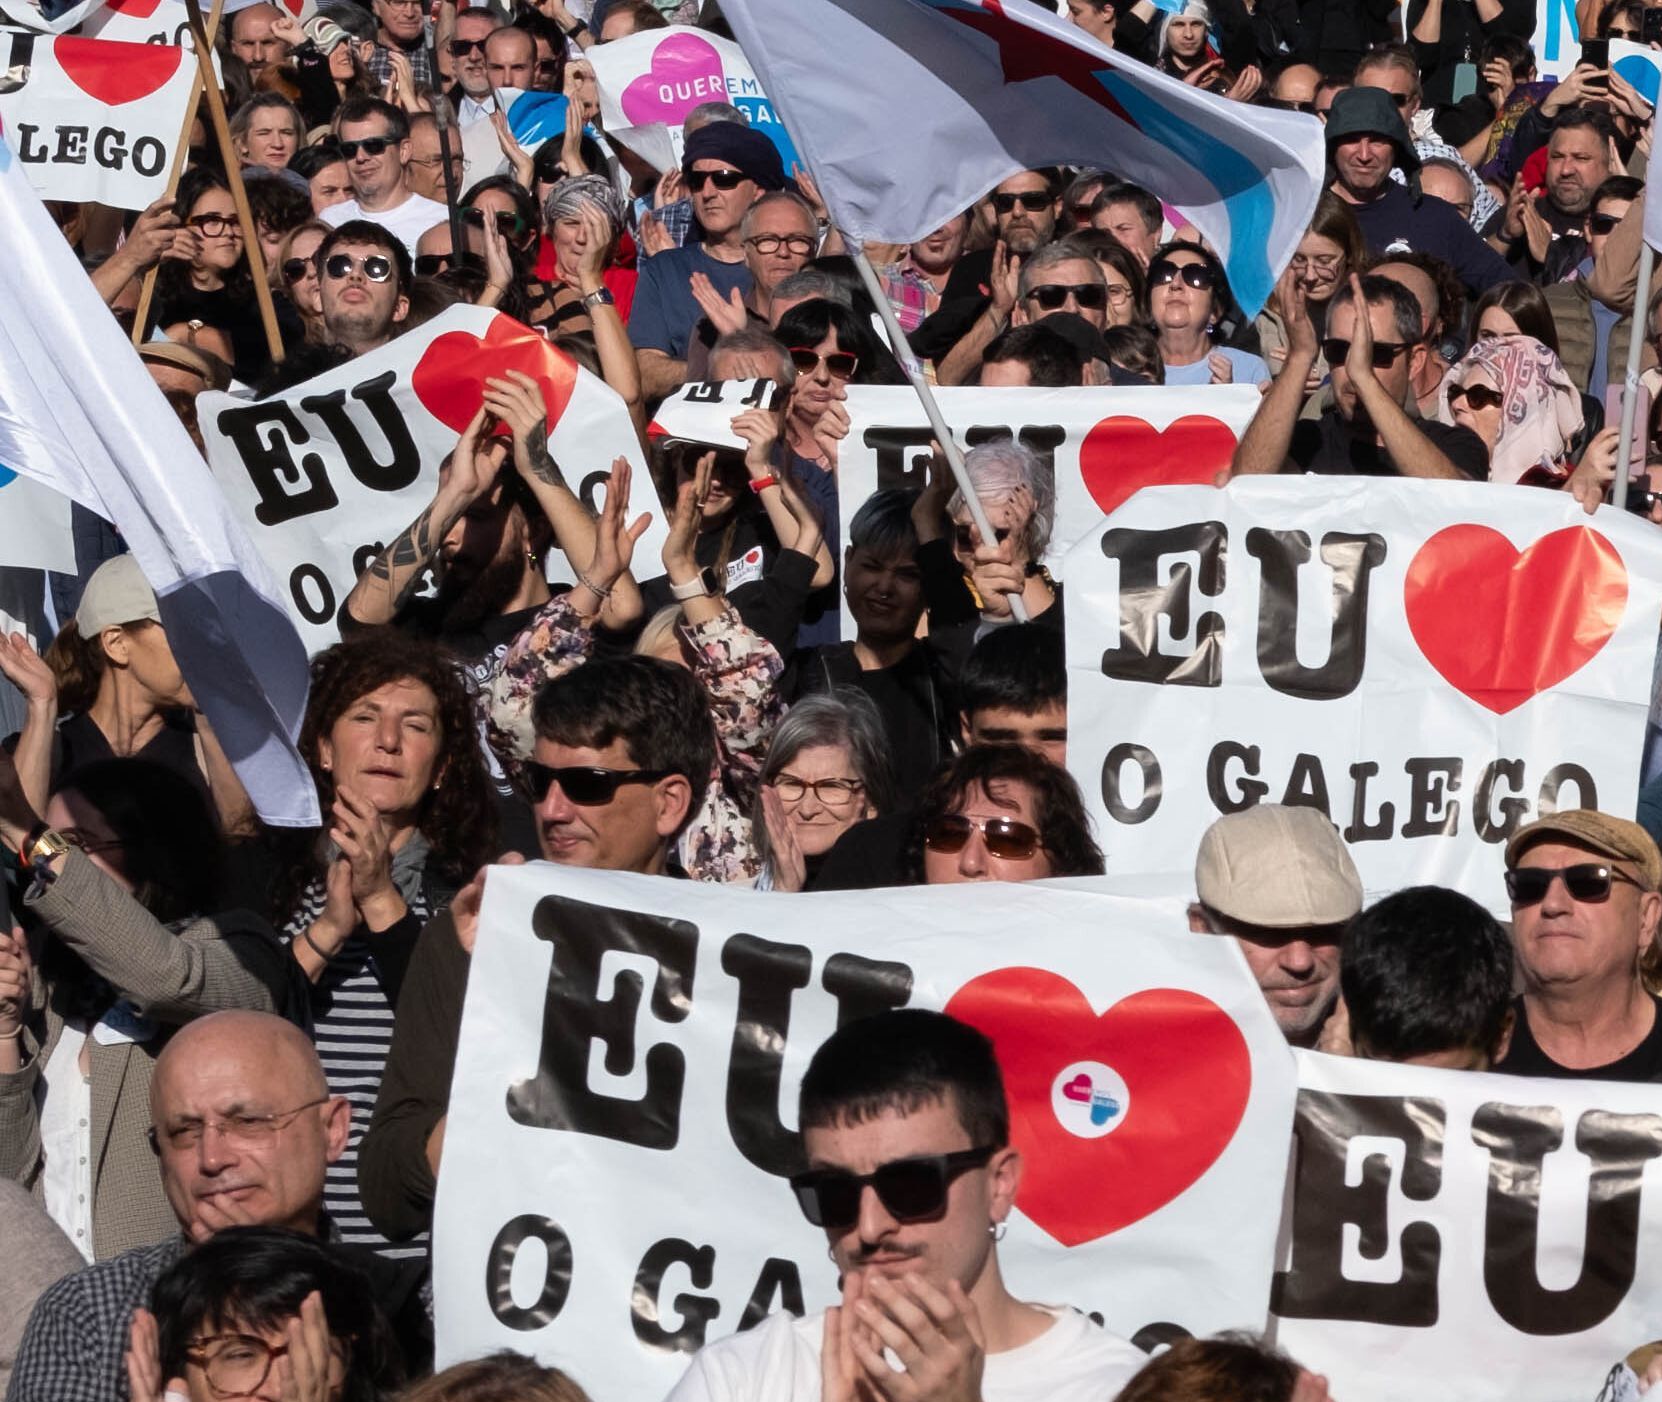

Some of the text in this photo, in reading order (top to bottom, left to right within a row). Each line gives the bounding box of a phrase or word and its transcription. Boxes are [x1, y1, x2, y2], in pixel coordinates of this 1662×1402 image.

[658, 74, 759, 105] QUEREM
[18, 123, 167, 177] LEGO
[217, 370, 421, 526] EU
[289, 563, 336, 625] O
[1101, 520, 1388, 701] EU
[1101, 740, 1599, 844] O GALEGO
[506, 894, 914, 1180] EU
[486, 1213, 573, 1332] O
